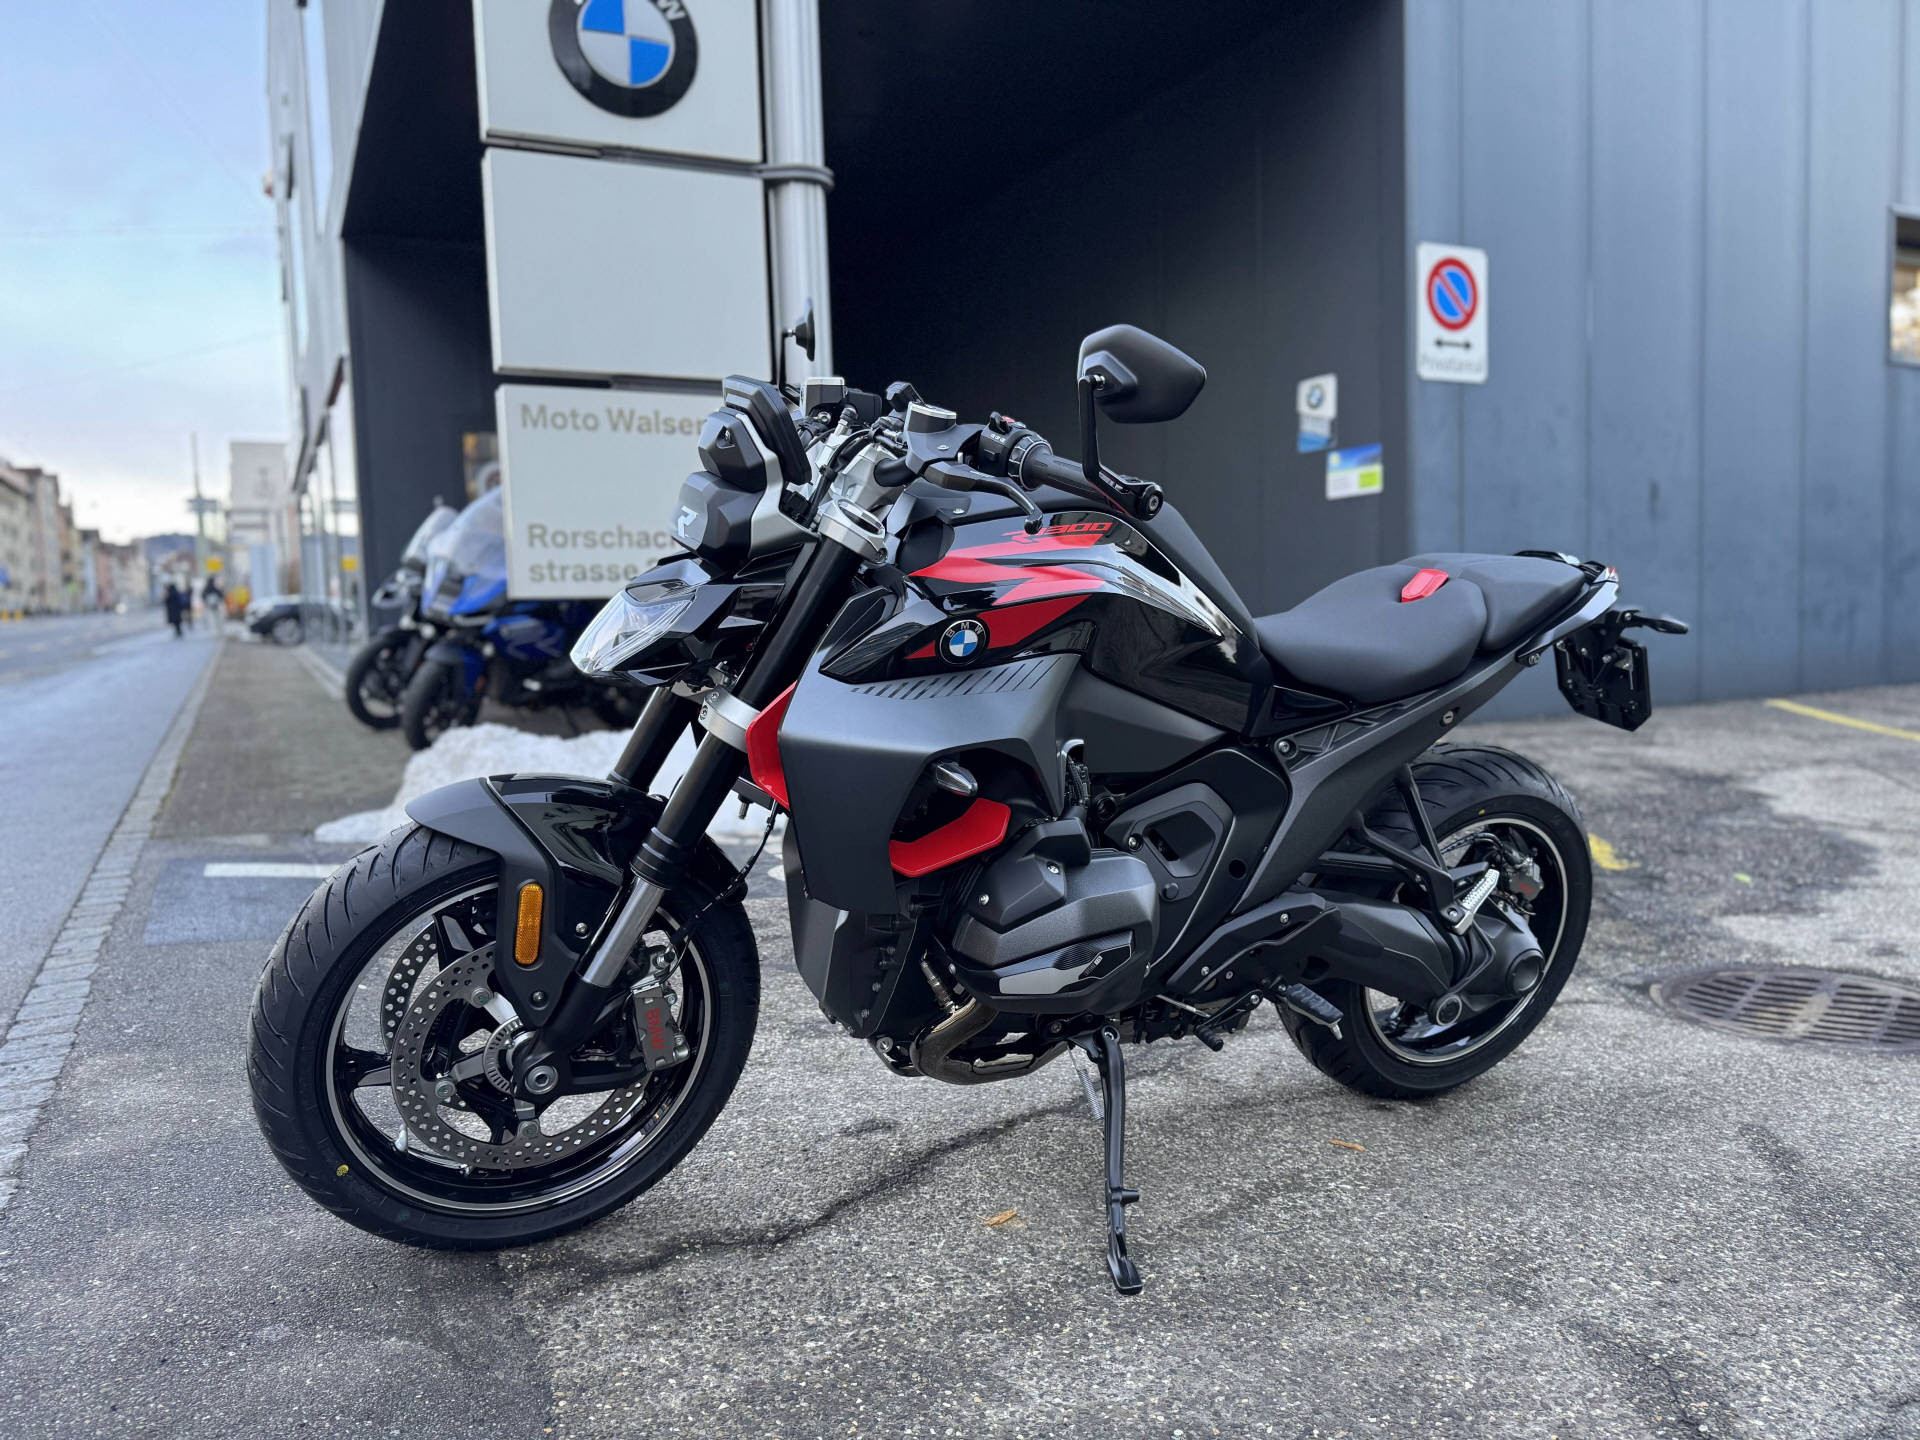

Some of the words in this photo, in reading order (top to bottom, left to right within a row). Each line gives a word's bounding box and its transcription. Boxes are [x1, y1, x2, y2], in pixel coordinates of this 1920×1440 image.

[521, 404, 599, 431] Moto
[606, 407, 707, 435] Walser
[528, 524, 676, 549] Rorschac
[529, 559, 638, 583] strasse
[945, 621, 984, 638] BMW
[645, 1008, 666, 1049] BMW
